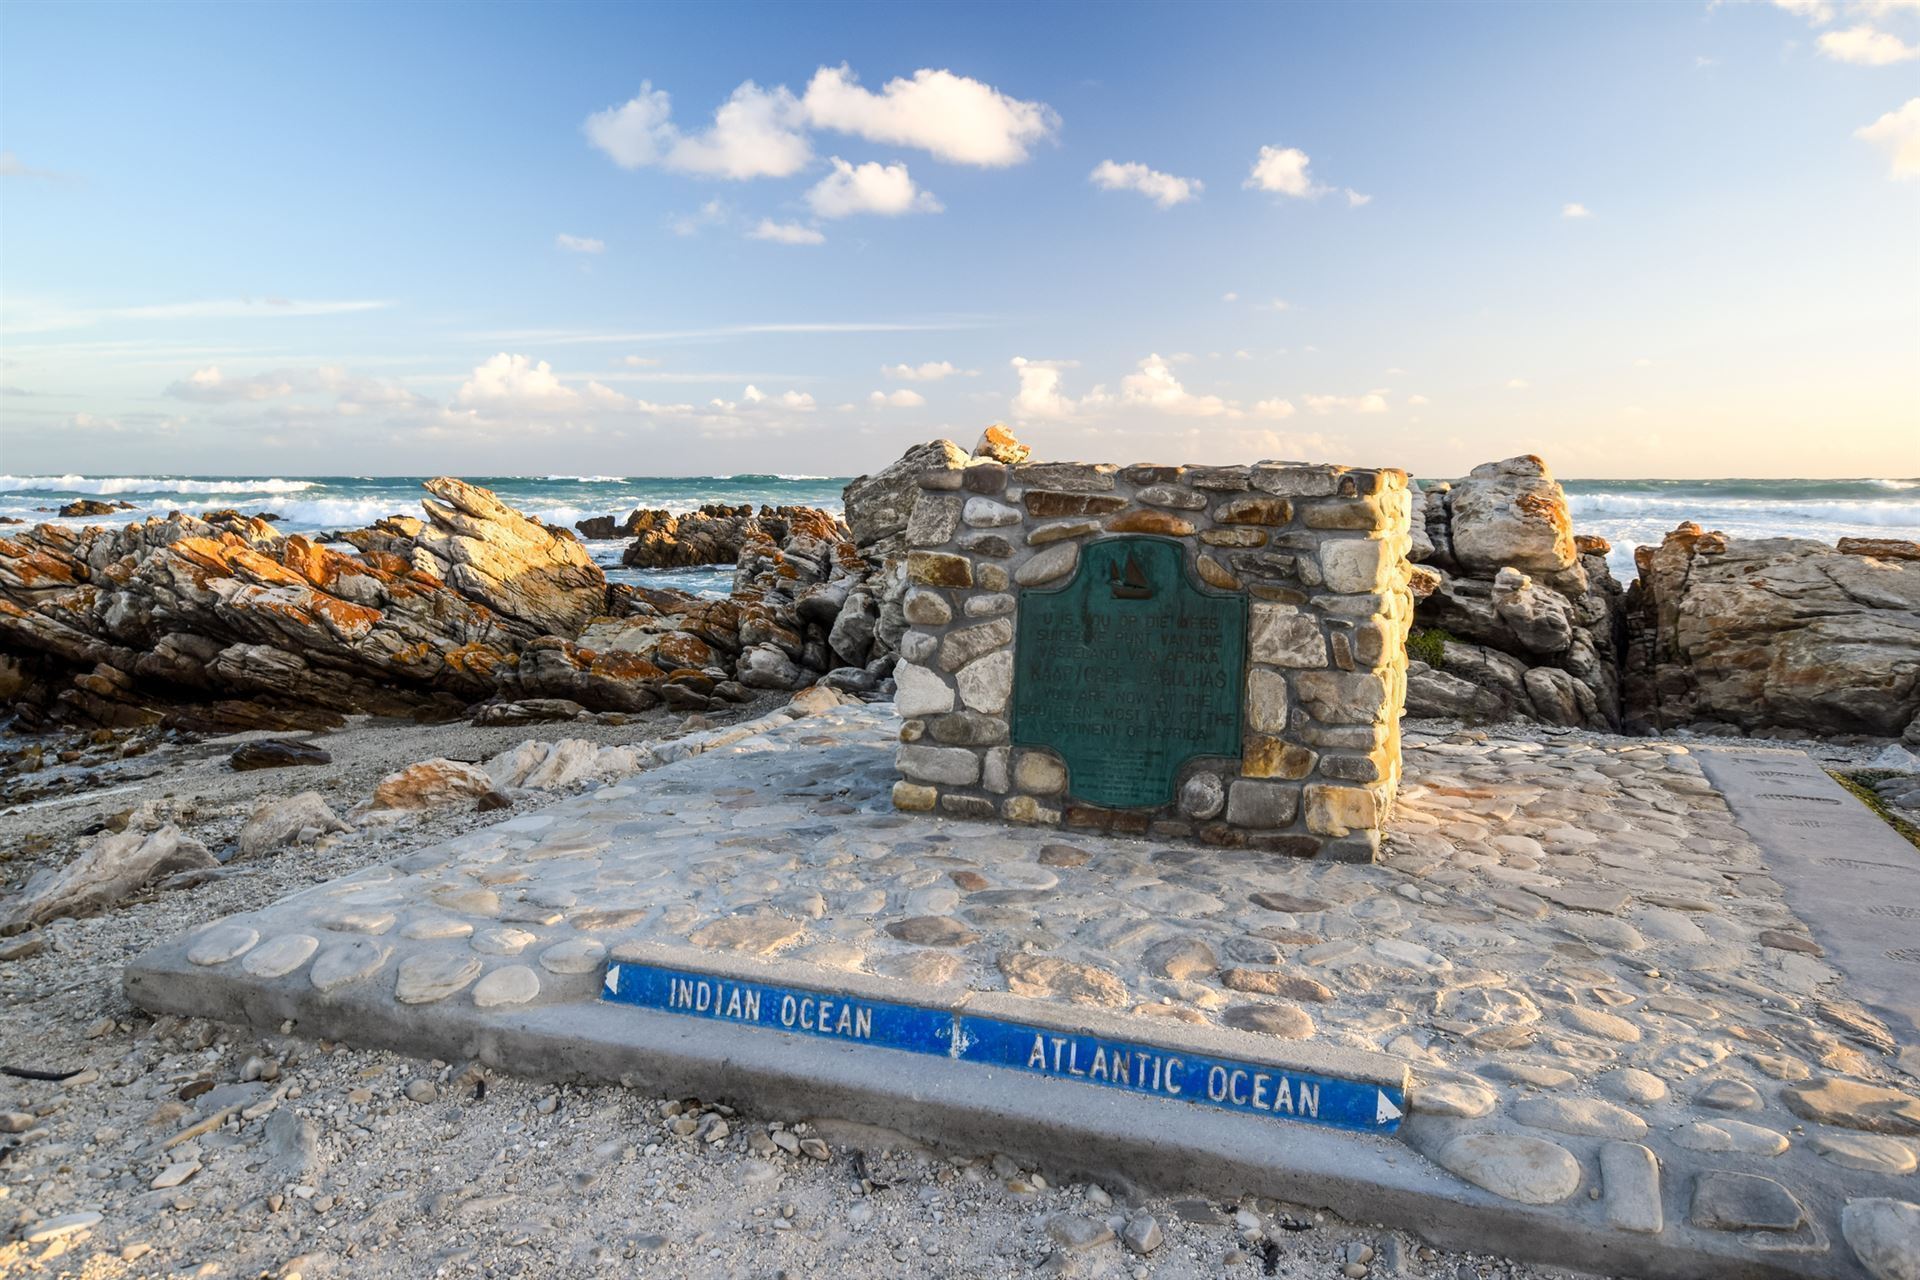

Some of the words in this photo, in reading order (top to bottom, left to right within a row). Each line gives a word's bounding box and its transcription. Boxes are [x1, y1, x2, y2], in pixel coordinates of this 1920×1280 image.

[1081, 614, 1112, 626] OU
[1120, 614, 1137, 627] OP
[1145, 615, 1169, 629] DIE
[1198, 634, 1224, 648] DIE
[1164, 651, 1220, 665] AFRIKA
[1207, 713, 1235, 726] THE
[669, 978, 761, 1021] INDIAN
[780, 994, 872, 1038] OCEAN
[1027, 1033, 1184, 1094] ATLANTIC
[1207, 1065, 1321, 1118] OCEAN
